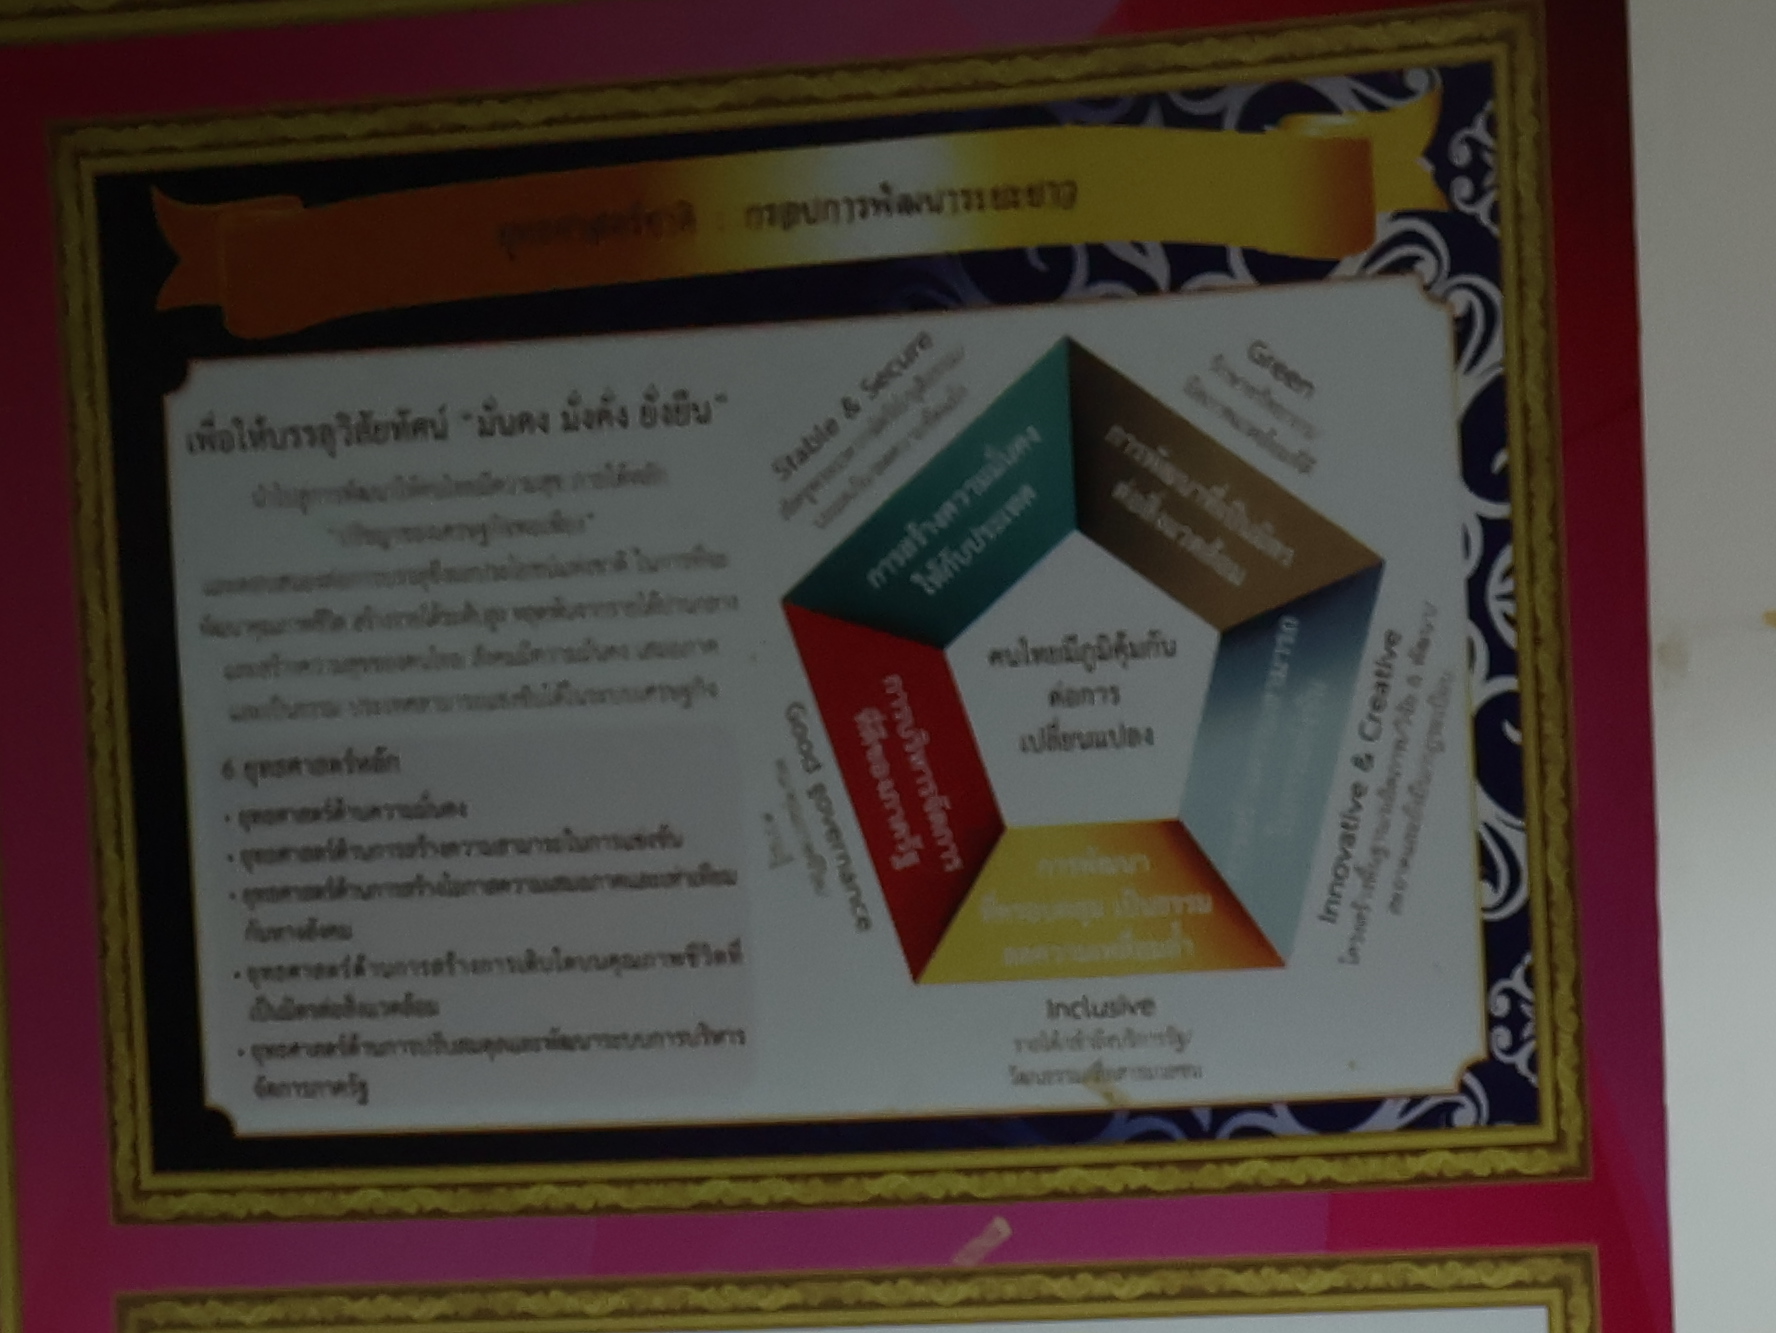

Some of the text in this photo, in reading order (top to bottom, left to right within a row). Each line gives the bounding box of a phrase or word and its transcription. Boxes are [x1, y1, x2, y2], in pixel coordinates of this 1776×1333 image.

[1247, 338, 1316, 400] Green
[772, 417, 843, 484] Stable
[859, 331, 934, 398] Secure
[1046, 994, 1156, 1021] Inclusive
